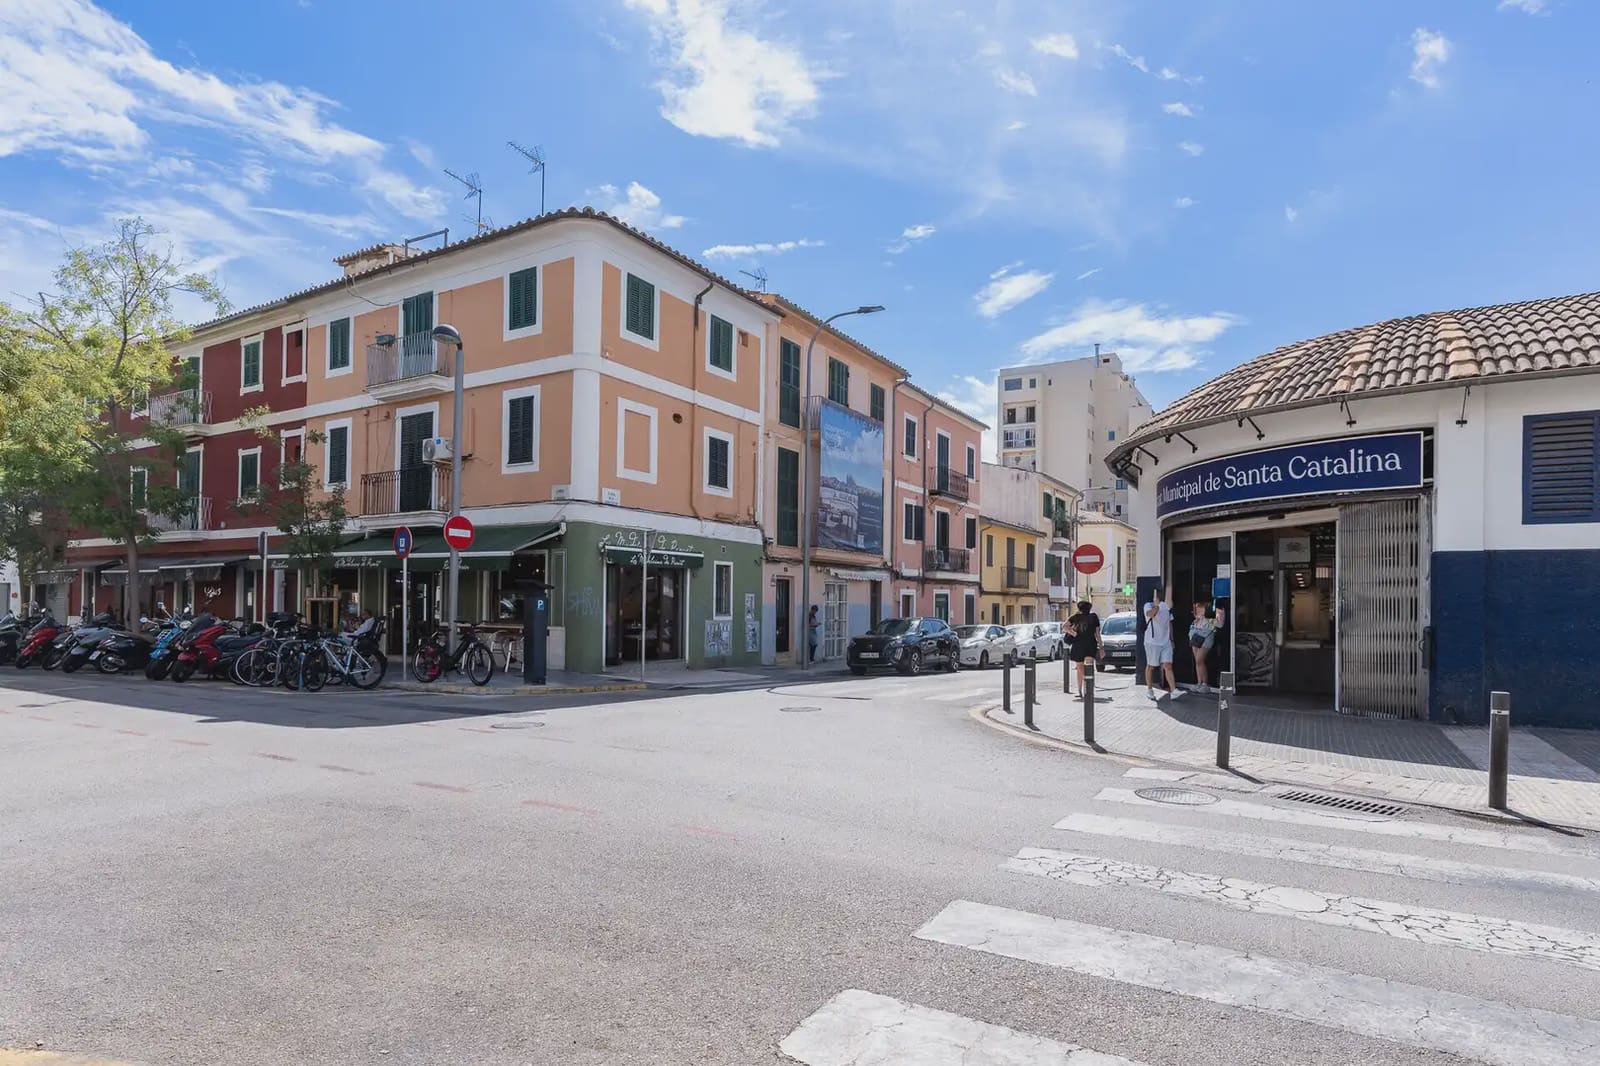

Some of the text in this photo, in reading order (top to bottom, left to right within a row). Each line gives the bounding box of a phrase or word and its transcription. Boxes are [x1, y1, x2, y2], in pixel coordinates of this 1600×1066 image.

[1162, 475, 1202, 503] Municipal
[1204, 472, 1221, 492] de
[1224, 463, 1283, 489] Santa
[1288, 448, 1402, 480] Catalina
[537, 600, 544, 609] P
